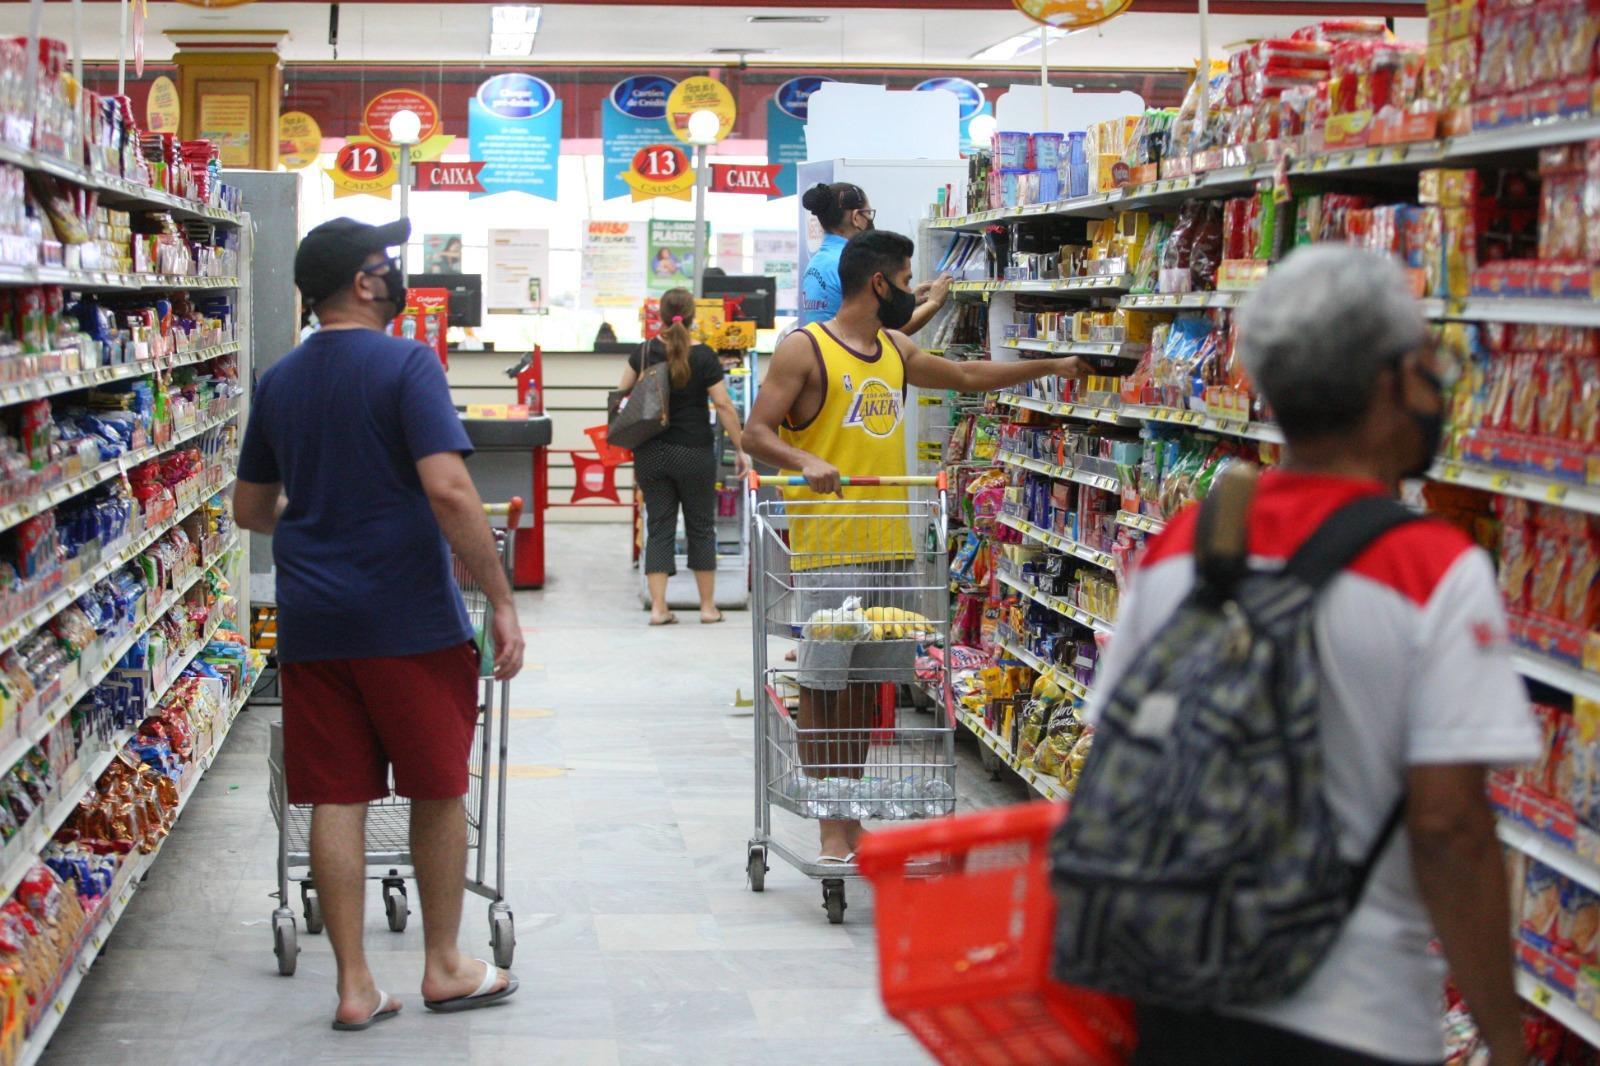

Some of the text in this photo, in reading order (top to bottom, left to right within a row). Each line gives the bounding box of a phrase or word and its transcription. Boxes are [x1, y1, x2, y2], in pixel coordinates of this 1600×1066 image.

[351, 147, 378, 172] 12
[648, 150, 676, 176] 13
[430, 167, 475, 185] CAIXA
[726, 169, 770, 189] CAIXA
[343, 180, 383, 190] CAIXA
[640, 184, 680, 193] CAIXA
[588, 221, 629, 234] AVISO
[416, 296, 445, 304] Colgate
